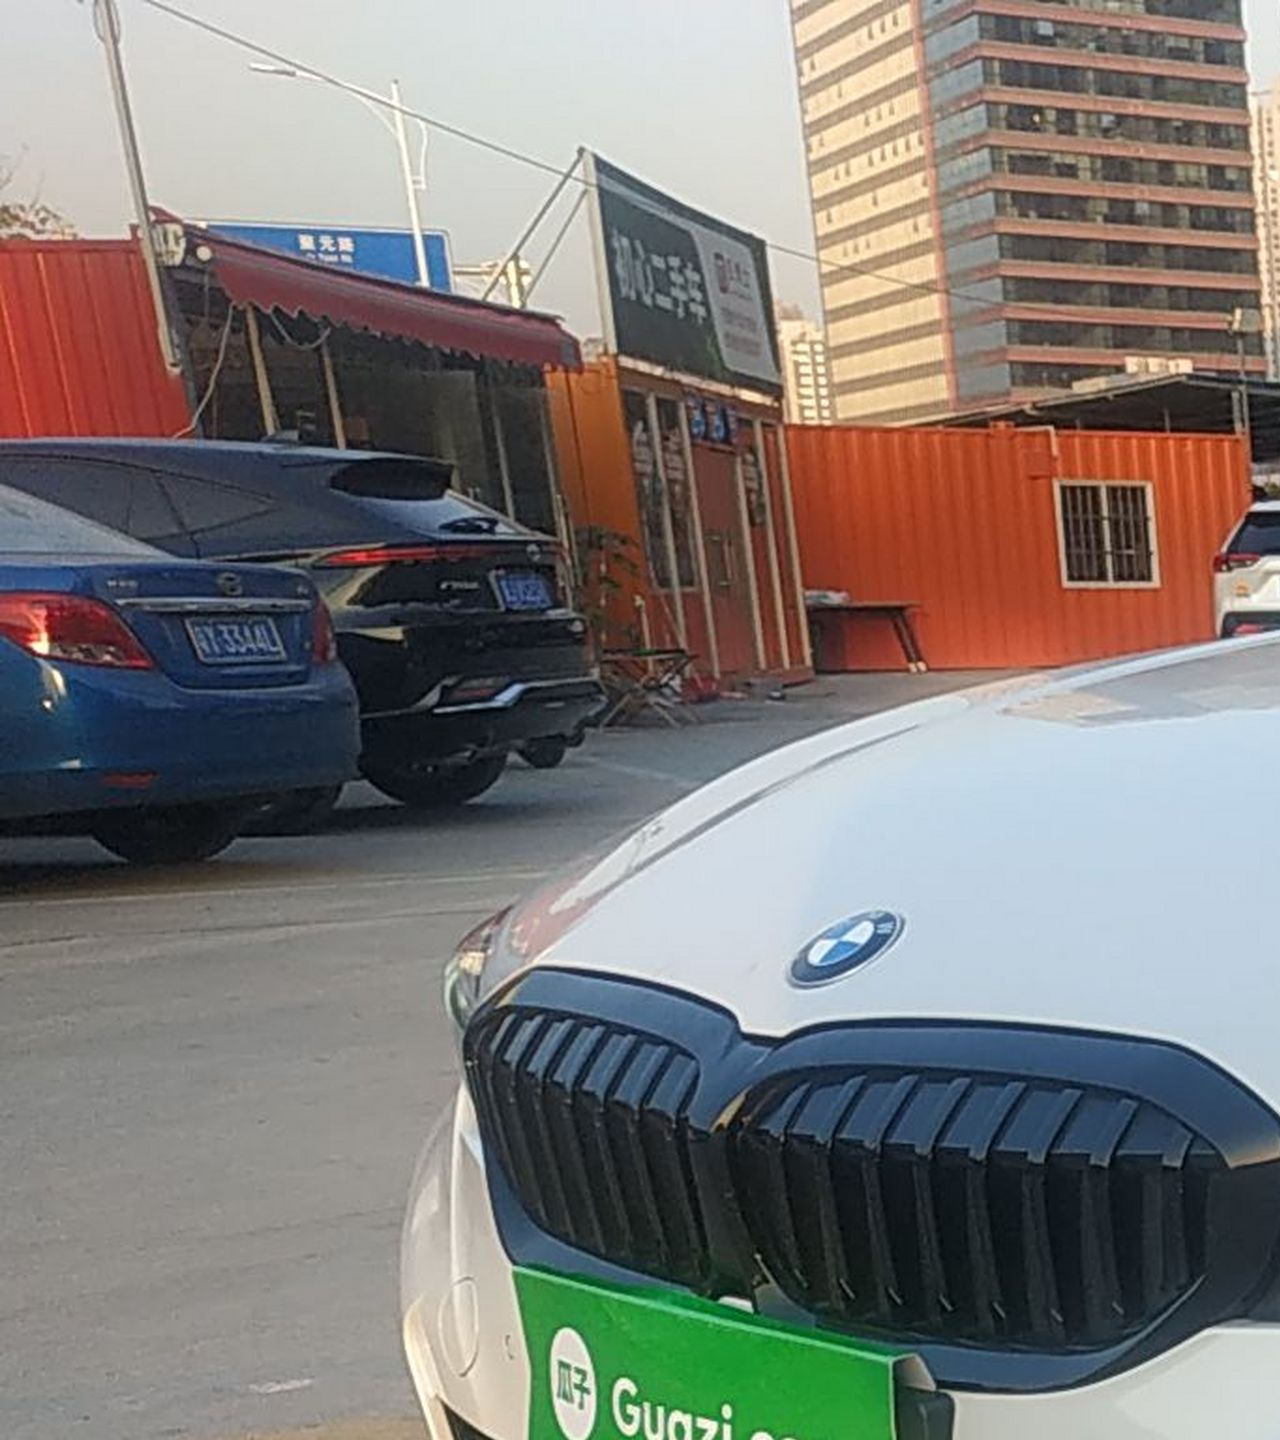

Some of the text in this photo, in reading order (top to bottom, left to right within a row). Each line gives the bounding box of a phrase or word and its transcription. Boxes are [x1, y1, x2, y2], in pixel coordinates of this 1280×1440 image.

[611, 227, 707, 324] 初心二手车
[557, 1360, 591, 1410] 瓜子
